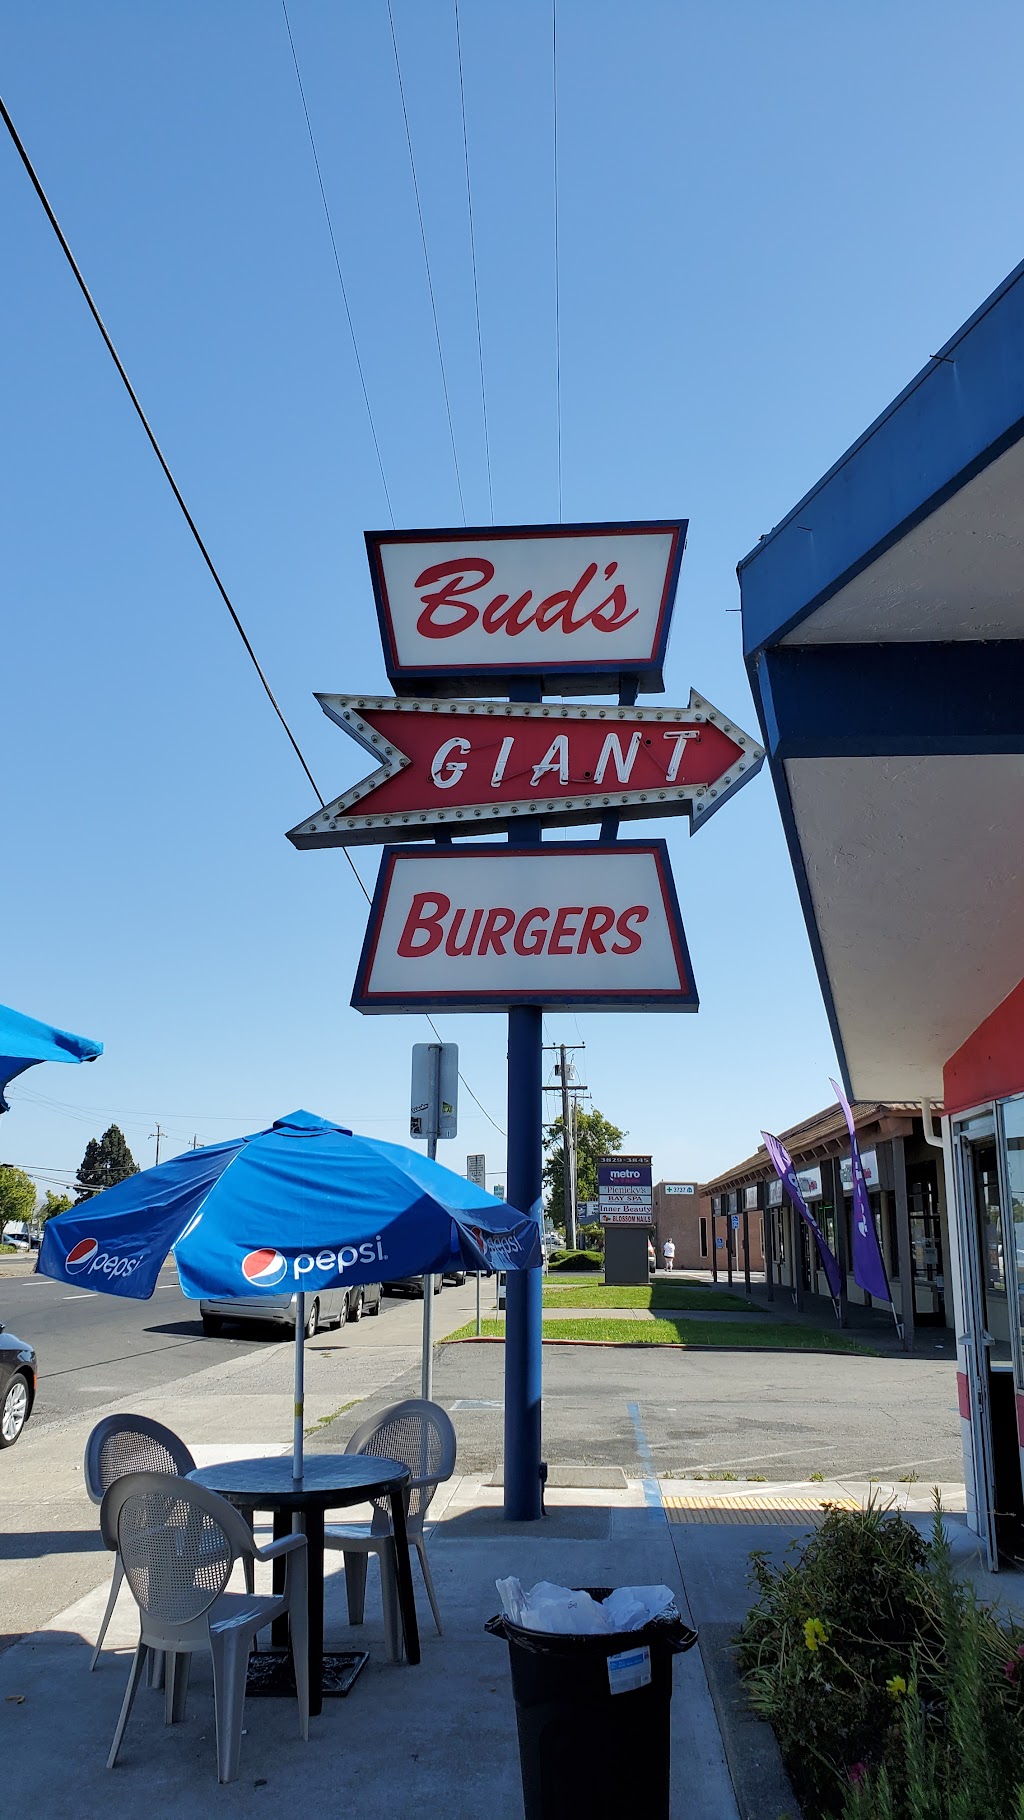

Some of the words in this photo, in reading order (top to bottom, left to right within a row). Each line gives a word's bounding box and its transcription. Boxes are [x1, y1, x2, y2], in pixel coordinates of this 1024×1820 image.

[413, 557, 640, 640] Bud's
[430, 729, 700, 789] GIANT
[396, 891, 650, 958] BURGERS
[610, 1169, 640, 1179] metro
[612, 1215, 636, 1223] BLOSSOM
[636, 1215, 651, 1223] NAILS
[623, 1205, 652, 1214] Beauty
[87, 1254, 144, 1280] pepsi
[293, 1234, 384, 1280] pepsi
